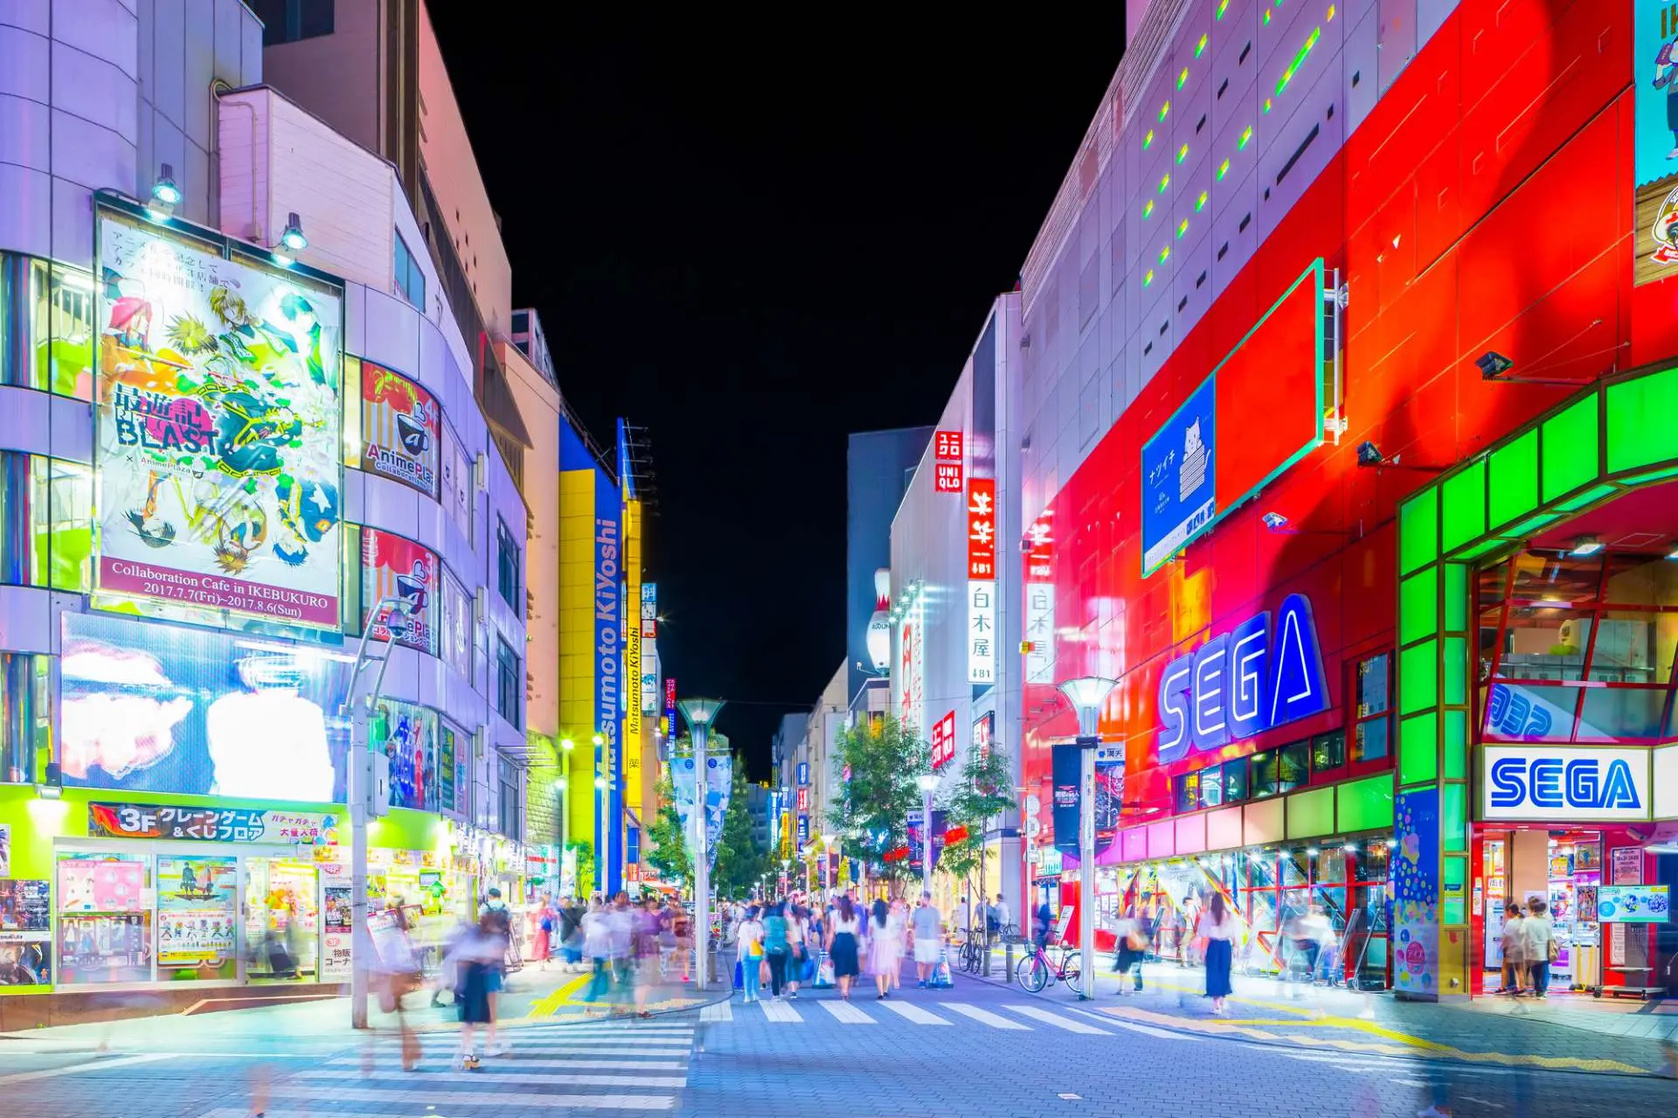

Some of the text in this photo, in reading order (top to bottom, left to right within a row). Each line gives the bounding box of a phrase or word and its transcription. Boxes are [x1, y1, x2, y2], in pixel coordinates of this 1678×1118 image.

[116, 419, 219, 456] BLAST
[1149, 449, 1176, 485] ナツイチ
[112, 562, 328, 609] Collaboration Cafe in IKEBUKURO
[597, 519, 617, 621] KiYoshi
[972, 587, 991, 658] 白木屋
[630, 627, 640, 669] KiYoshi
[630, 670, 640, 735] Matsumoto
[1159, 593, 1332, 765] SEGA
[1491, 758, 1641, 809] SEGA
[119, 808, 157, 833] 3F
[160, 808, 263, 827] クレーンゲーム
